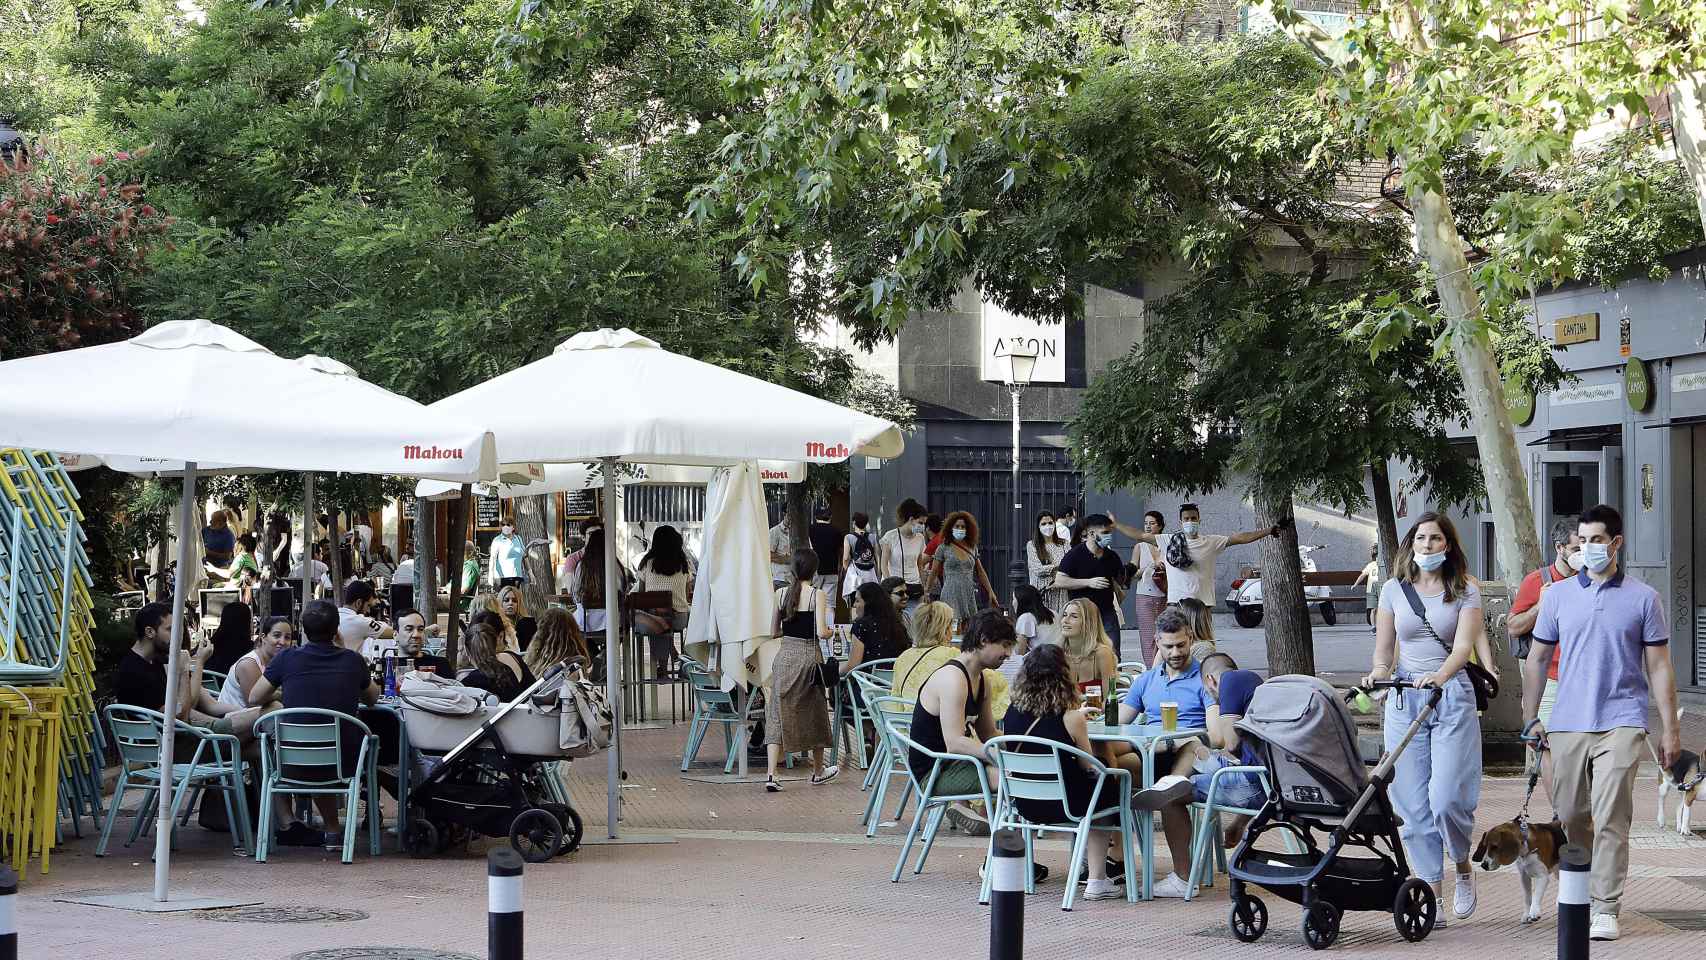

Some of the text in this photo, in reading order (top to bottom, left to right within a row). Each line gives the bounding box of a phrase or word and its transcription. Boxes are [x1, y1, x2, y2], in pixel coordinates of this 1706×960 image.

[1563, 322, 1587, 337] CANTINA
[993, 337, 1056, 357] AON
[403, 445, 463, 460] Mahou
[806, 442, 849, 457] Mah
